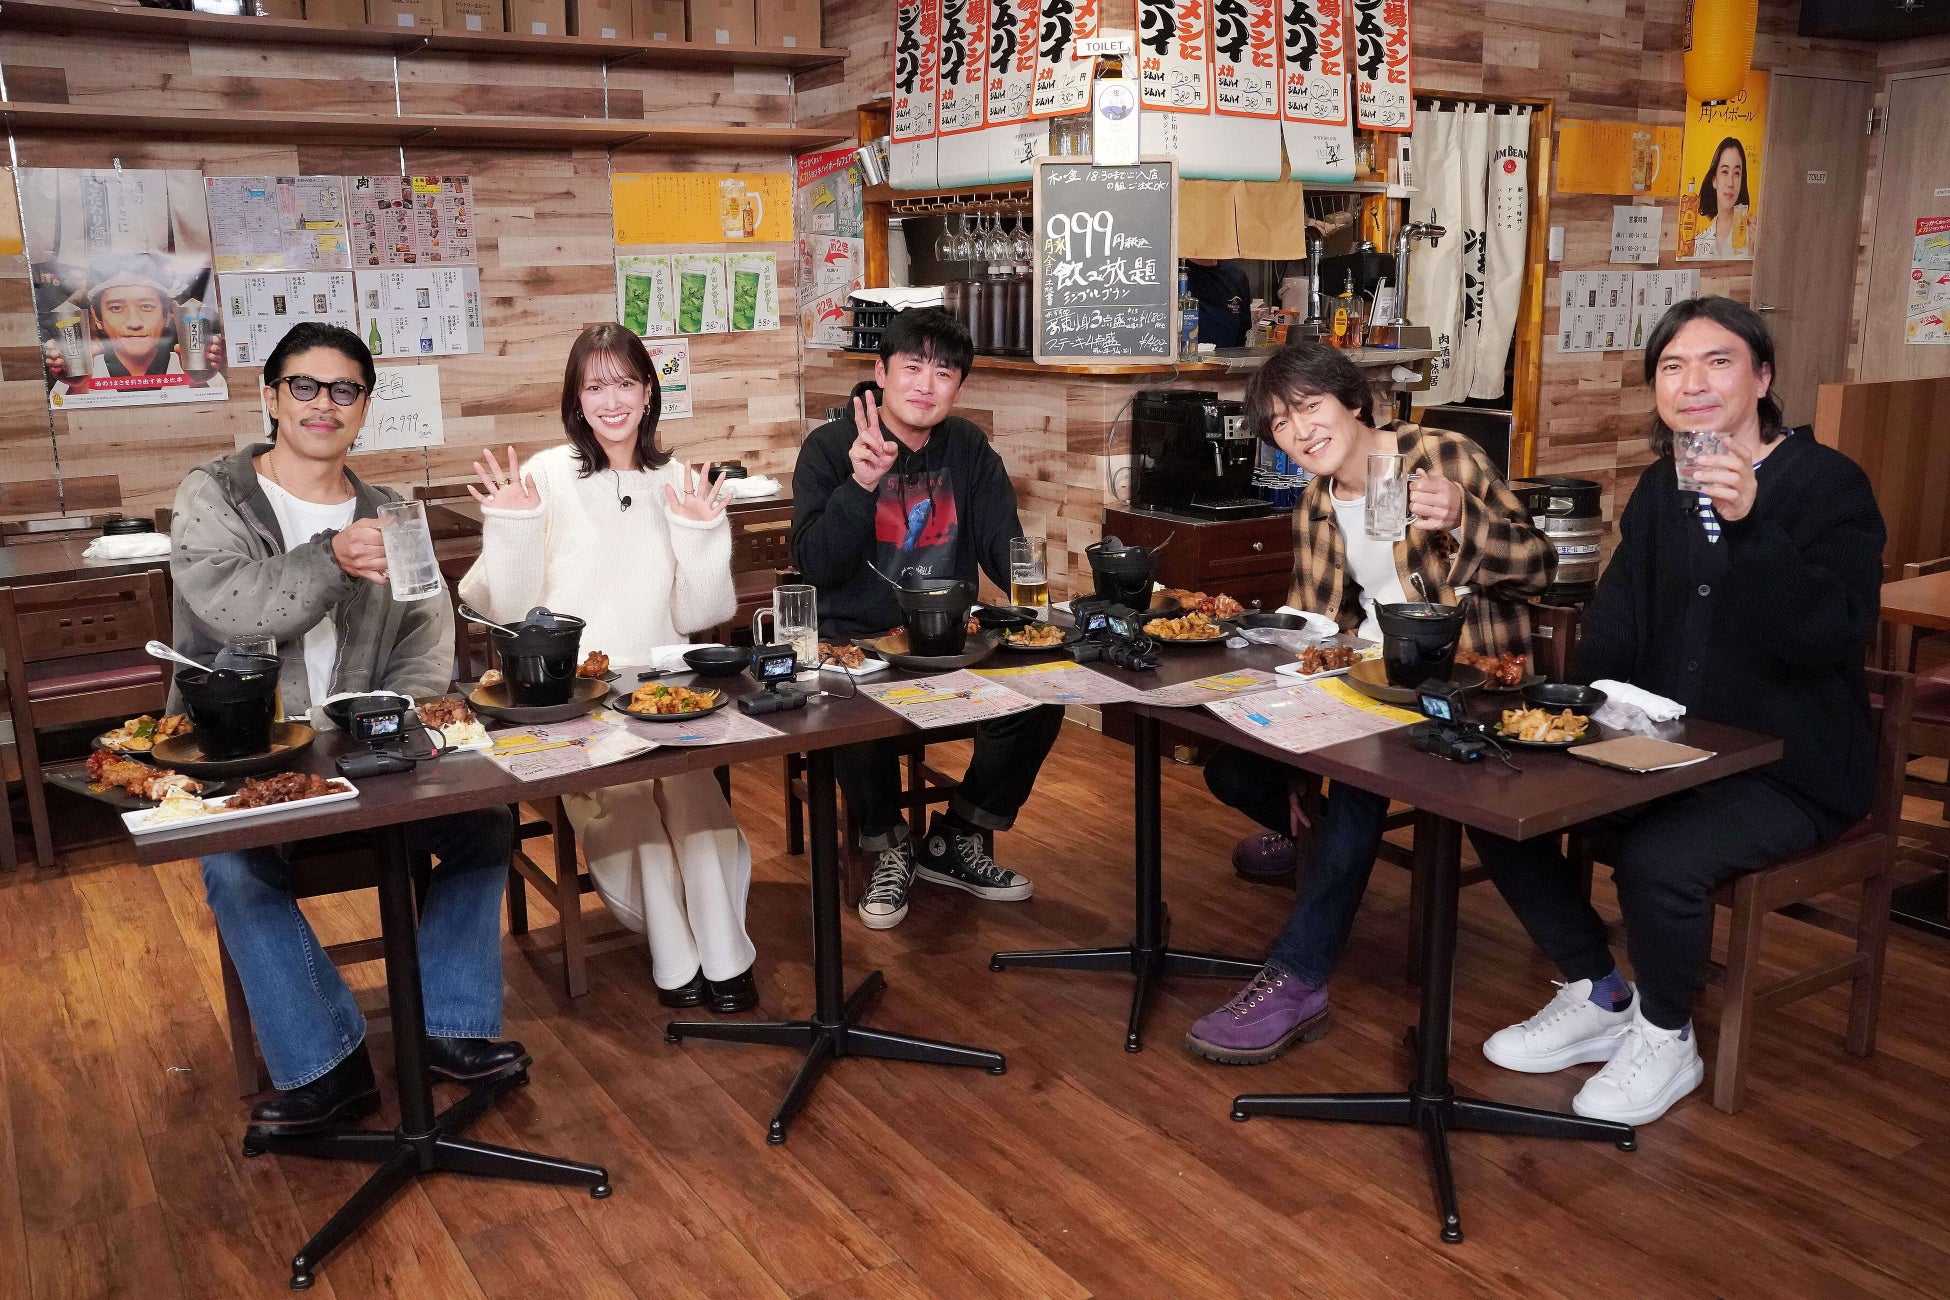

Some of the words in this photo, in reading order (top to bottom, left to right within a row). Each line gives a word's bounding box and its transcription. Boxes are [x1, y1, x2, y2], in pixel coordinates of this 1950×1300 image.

[896, 4, 920, 94] ジムハイ
[1086, 41, 1124, 52] TOILET
[1143, 58, 1161, 71] メガ
[1218, 65, 1235, 77] メガ
[1038, 67, 1053, 81] メガ
[1144, 70, 1165, 82] ジムハイ
[1194, 74, 1200, 83] 円
[1288, 74, 1305, 86] メガ
[990, 78, 1003, 91] メガ
[1037, 80, 1056, 91] ジムハイ
[1080, 73, 1086, 82] 円
[1219, 77, 1238, 88] ジムハイ
[1266, 81, 1272, 89] 円
[1360, 82, 1372, 94] メガ
[942, 89, 954, 101] メガ
[1144, 87, 1166, 98] ジムハイ
[1195, 91, 1201, 100] 円
[1288, 85, 1309, 96] ジムハイ
[1333, 88, 1339, 97] 円
[1035, 95, 1054, 106] ジムハイ
[1077, 91, 1084, 99] 円
[1219, 93, 1240, 104] ジムハイ
[1266, 98, 1272, 107] 円
[1360, 94, 1375, 104] ジムハイ
[1399, 95, 1405, 104] 円
[1288, 101, 1309, 112] ジムハイ
[1333, 105, 1339, 113] 円
[1360, 109, 1377, 119] ジムハイ
[1399, 112, 1405, 120] 円
[356, 177, 369, 190] 肉
[1047, 211, 1114, 261] 999
[191, 323, 199, 348] タコハイ
